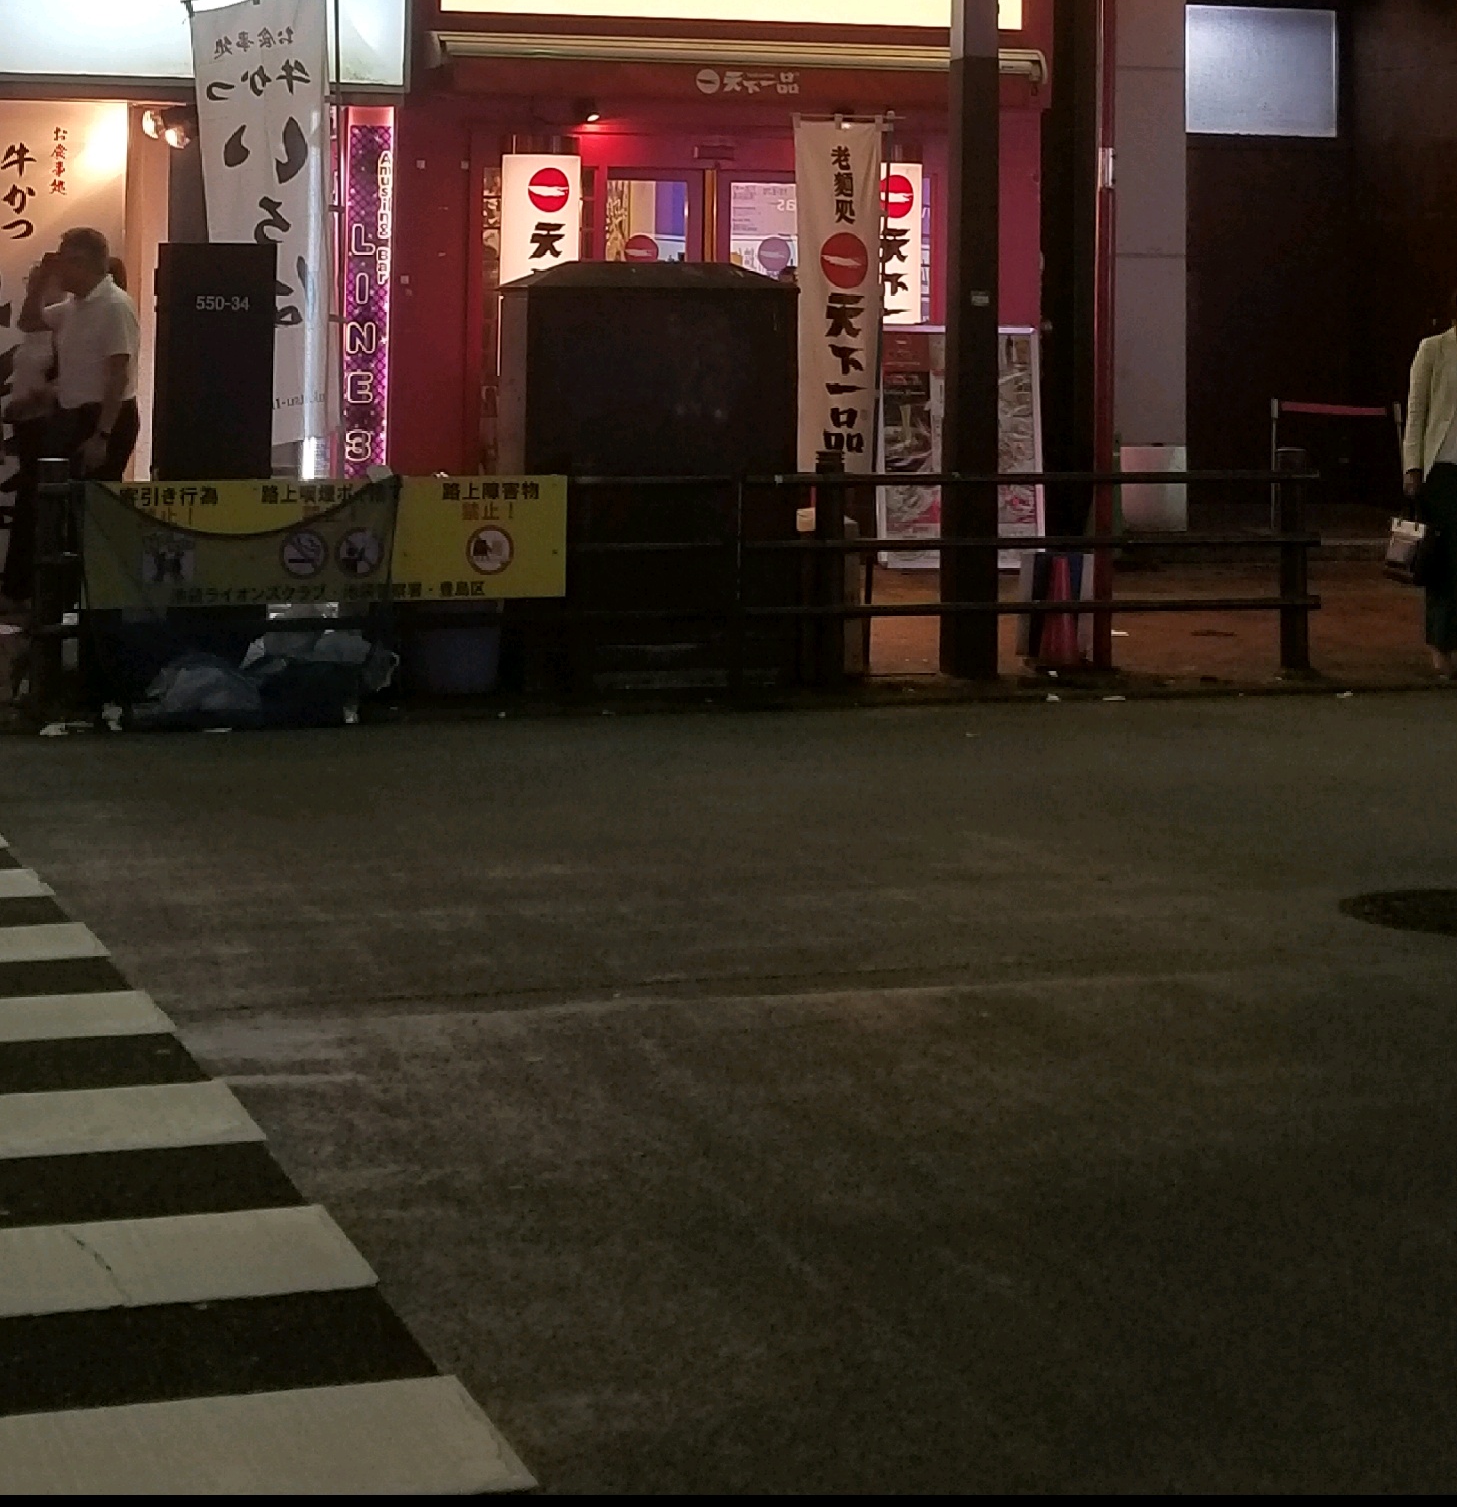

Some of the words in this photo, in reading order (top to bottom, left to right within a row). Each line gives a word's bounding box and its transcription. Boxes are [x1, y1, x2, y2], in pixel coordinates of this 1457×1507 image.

[0, 142, 37, 240] 牛かつ
[346, 224, 376, 405] LINE
[824, 292, 866, 454] 天下一品
[345, 430, 372, 463] 3
